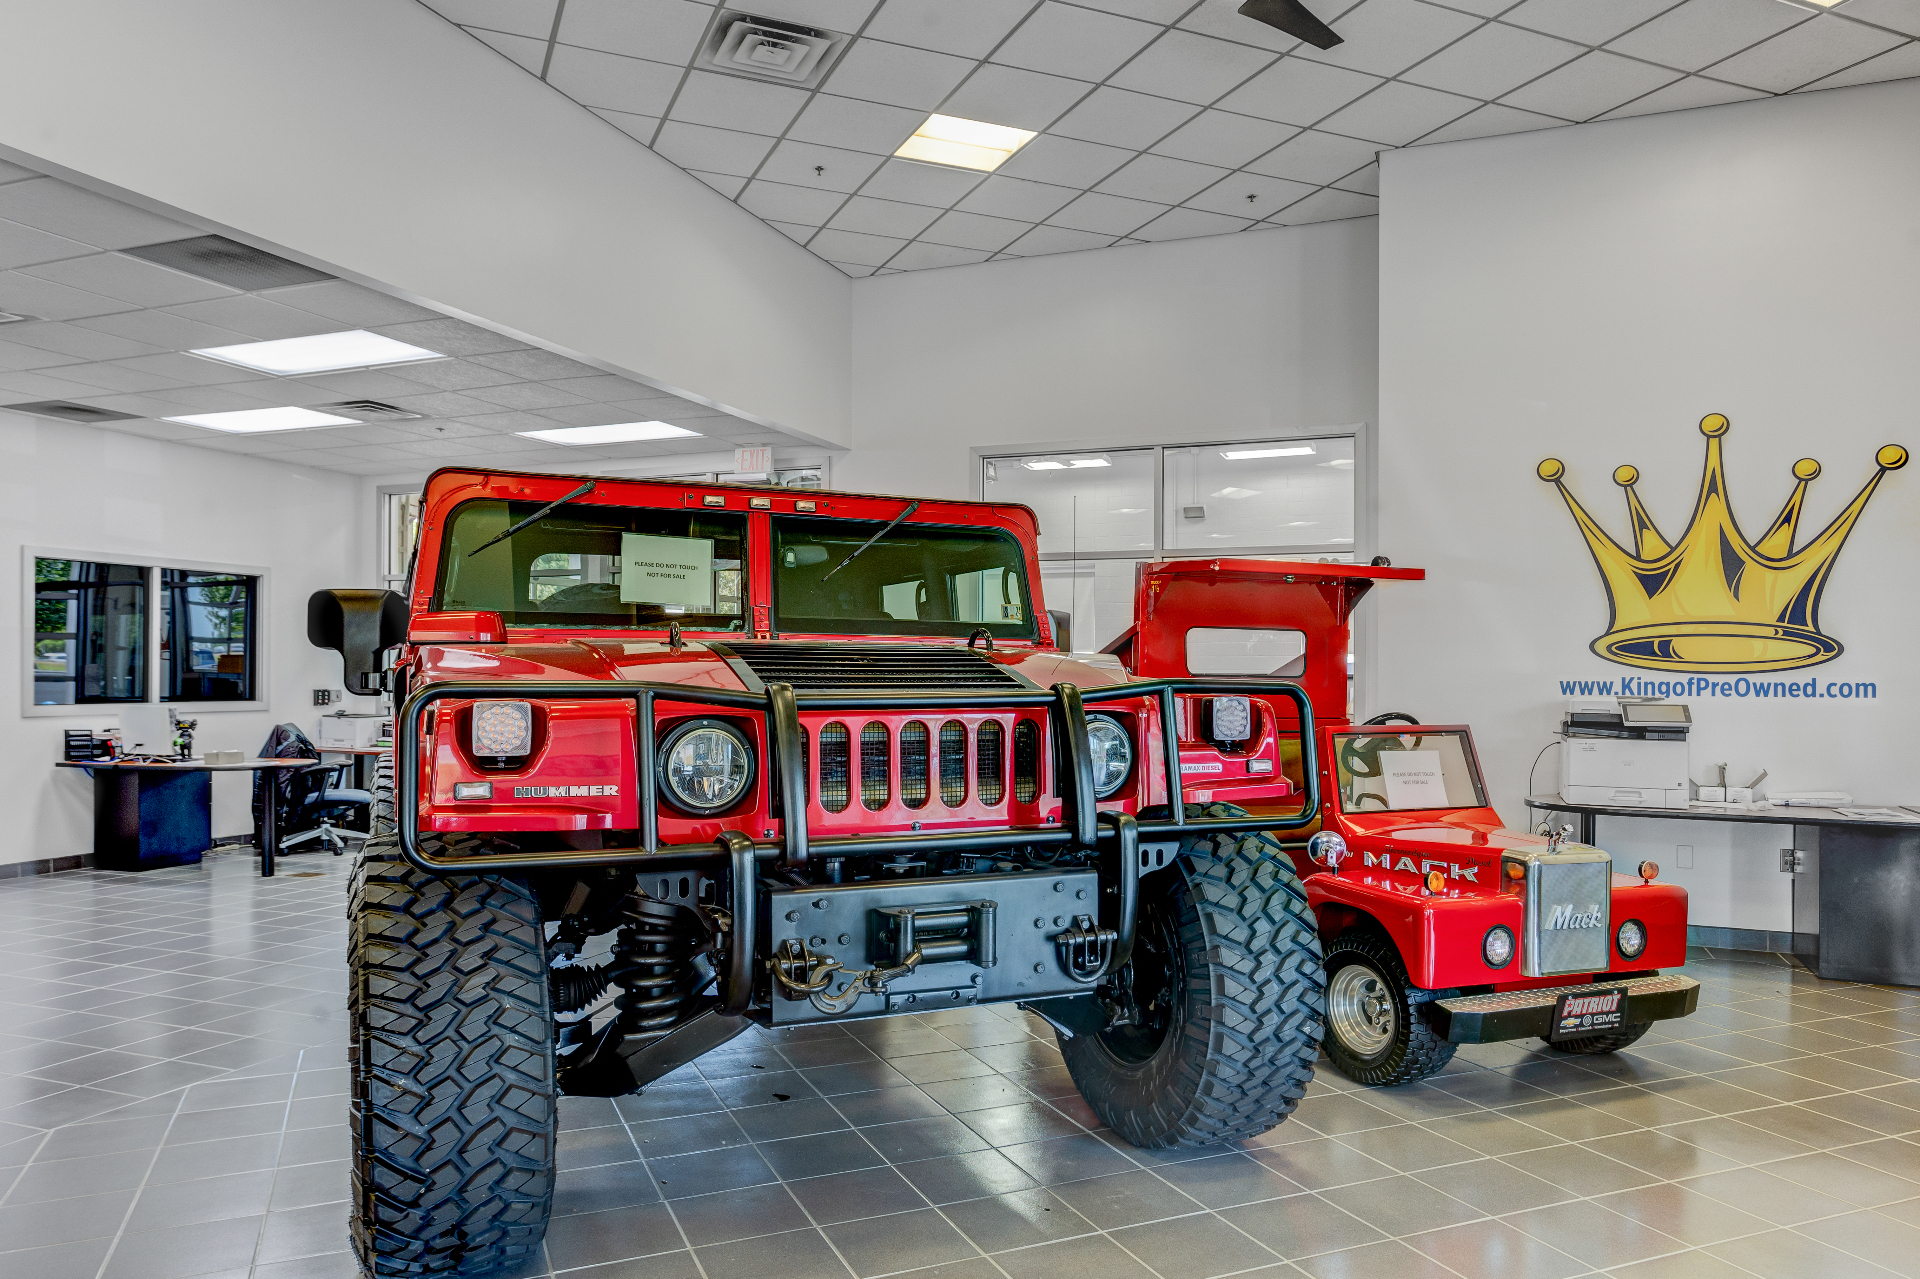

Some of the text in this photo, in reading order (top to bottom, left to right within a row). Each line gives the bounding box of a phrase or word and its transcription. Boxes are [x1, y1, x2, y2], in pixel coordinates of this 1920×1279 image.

[740, 449, 767, 471] EXIT
[1559, 676, 1877, 699] www.KingofPreOwned.com
[514, 784, 620, 799] HUMMER
[1382, 844, 1431, 859] Thermodyne
[1465, 856, 1493, 868] Diesel
[1544, 902, 1602, 930] Mack
[1562, 993, 1622, 1017] PATRIOT
[1594, 1013, 1621, 1024] GMC
